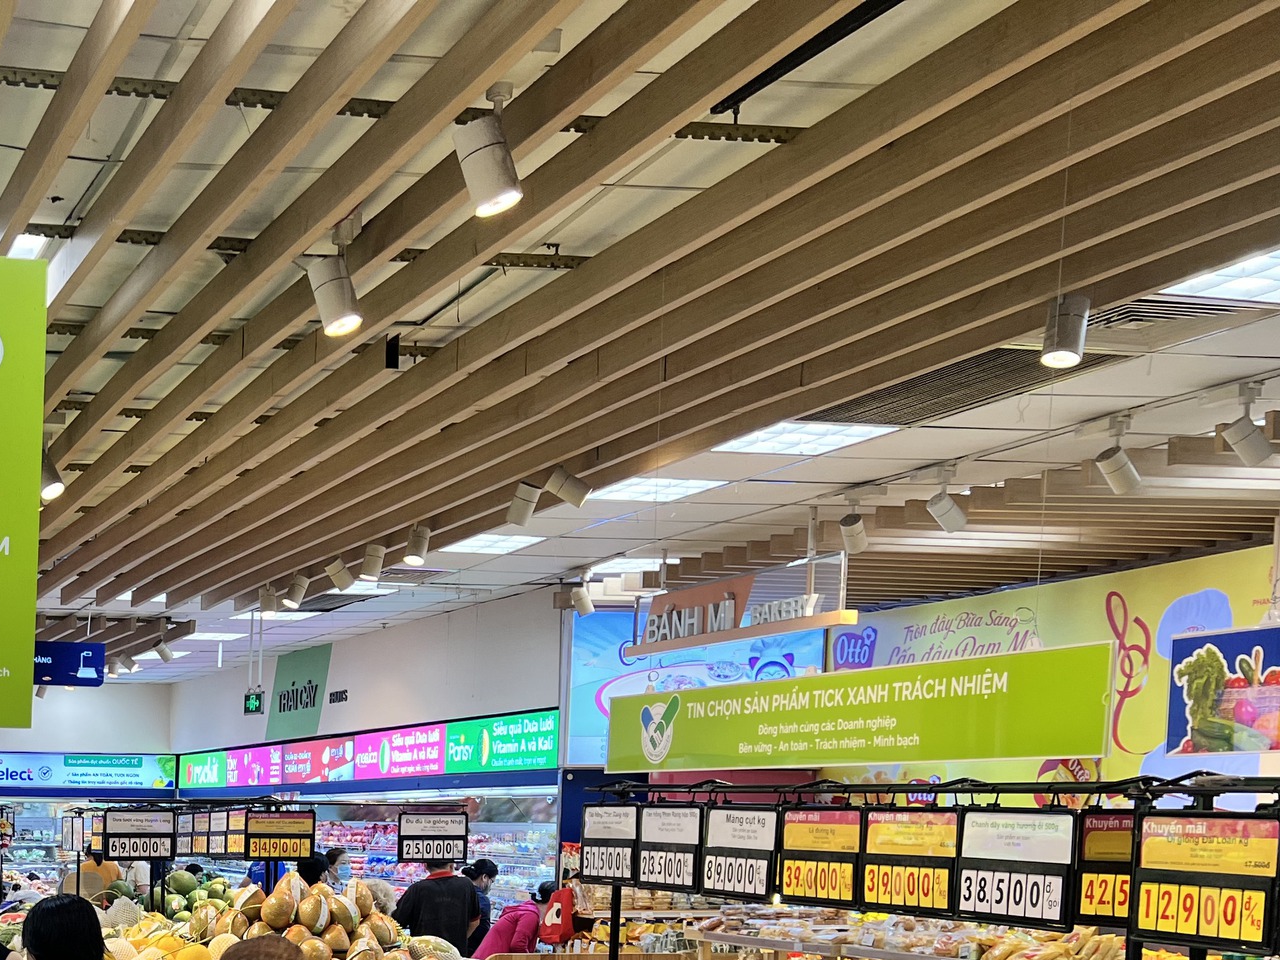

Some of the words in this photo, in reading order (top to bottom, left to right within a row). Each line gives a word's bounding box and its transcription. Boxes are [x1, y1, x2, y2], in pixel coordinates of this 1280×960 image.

[646, 603, 703, 644] BÁNH
[707, 592, 735, 634] MÌ
[750, 594, 824, 626] BAKERY
[904, 624, 927, 646] Tròn
[986, 610, 1020, 635] Sáng
[837, 635, 870, 664] Otto
[279, 682, 298, 713] TRÁI
[300, 680, 318, 709] CÂY
[687, 702, 705, 719] TIN
[708, 700, 741, 719] CHỌN
[744, 691, 769, 713] SẢN
[772, 687, 810, 712] PHẨM
[812, 689, 843, 708] TICK
[847, 683, 889, 705] XANH
[892, 676, 946, 701] TRÁCH
[950, 669, 1008, 700] NHIỆM
[493, 720, 507, 736] Siêu
[524, 719, 538, 733] Dưa
[758, 722, 777, 737] Đồng
[779, 722, 799, 734] hành
[800, 720, 819, 736] cùng
[821, 719, 835, 732] các
[837, 717, 864, 730] Doanh
[866, 716, 897, 730] nghiệp
[492, 739, 518, 754] Vitamin
[520, 738, 526, 752] A
[528, 736, 536, 751] và
[538, 735, 553, 751] Kali
[739, 742, 752, 753] Bền
[754, 741, 772, 754] vững
[779, 741, 789, 751] An
[790, 740, 808, 751] toàn
[815, 738, 837, 749] Trách
[839, 737, 865, 750] nhiệm
[873, 735, 894, 747] Minh
[897, 733, 919, 747] bạch
[757, 817, 765, 827] kg
[868, 812, 894, 822] Khuyến
[895, 813, 909, 821] mãi
[1086, 817, 1119, 830] Khuyến
[1143, 821, 1182, 835] Khuyến
[1186, 822, 1206, 834] mãi
[112, 840, 158, 854] 69.000
[252, 841, 298, 853] 34.900
[406, 843, 452, 855] 25.000
[585, 852, 620, 871] 51.500
[642, 854, 682, 879] 23.500
[707, 859, 754, 885] 89.000
[785, 865, 837, 890] 39.000
[868, 869, 930, 897] 39.000
[963, 877, 1040, 908] 38.500
[1145, 889, 1237, 927] 12.900
